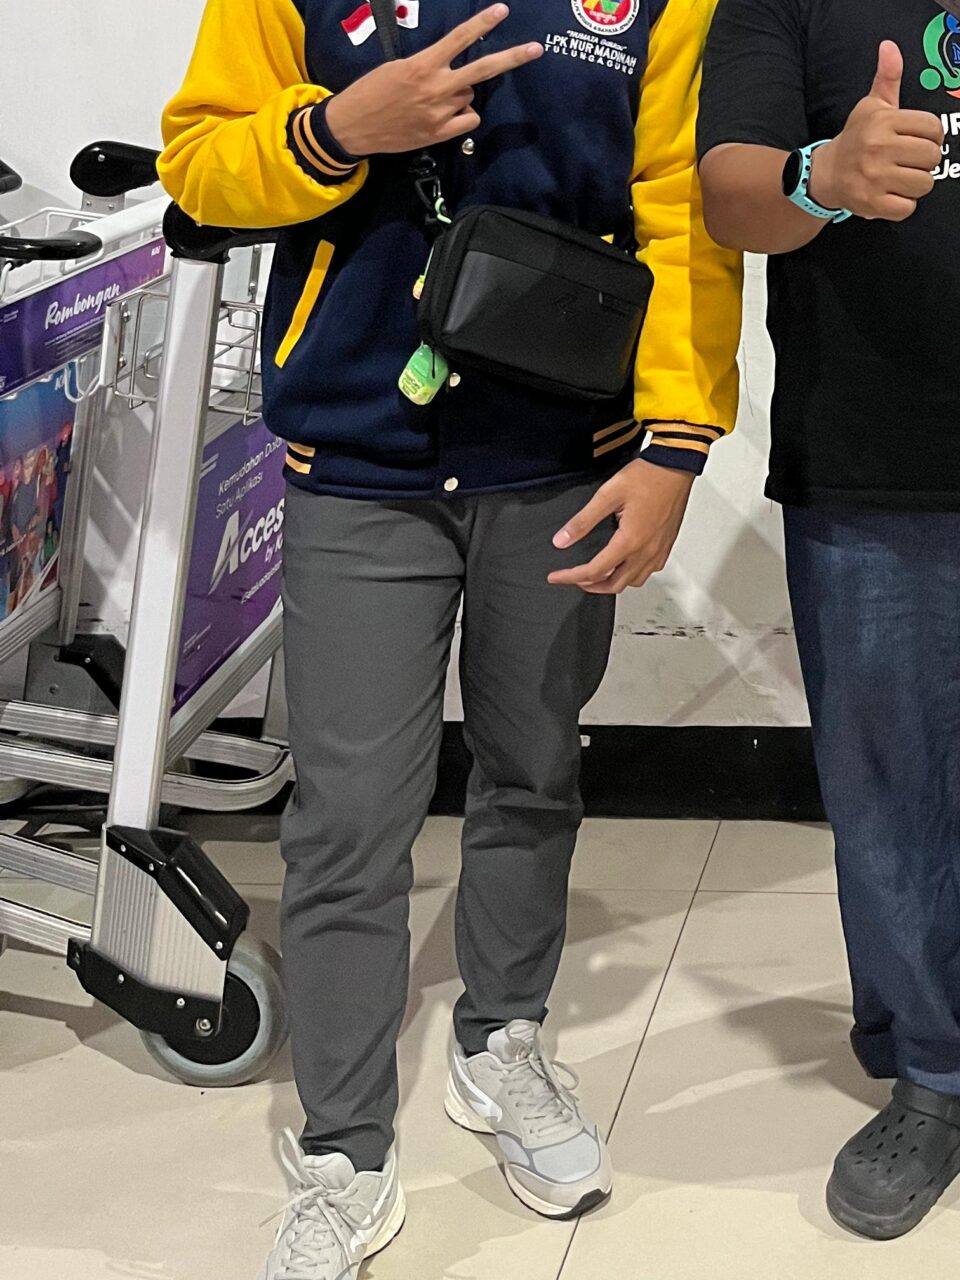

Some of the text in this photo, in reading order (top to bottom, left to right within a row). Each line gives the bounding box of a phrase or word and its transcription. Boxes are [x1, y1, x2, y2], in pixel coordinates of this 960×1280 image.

[544, 44, 634, 75] TULUNGAGUNG
[546, 34, 569, 47] LPK
[569, 39, 594, 54] NUR
[594, 45, 637, 68] MADINAH
[45, 283, 121, 331] Rombongan
[218, 448, 264, 496] Kemudahan
[234, 470, 264, 502] Aplikasi
[216, 495, 234, 520] Satu
